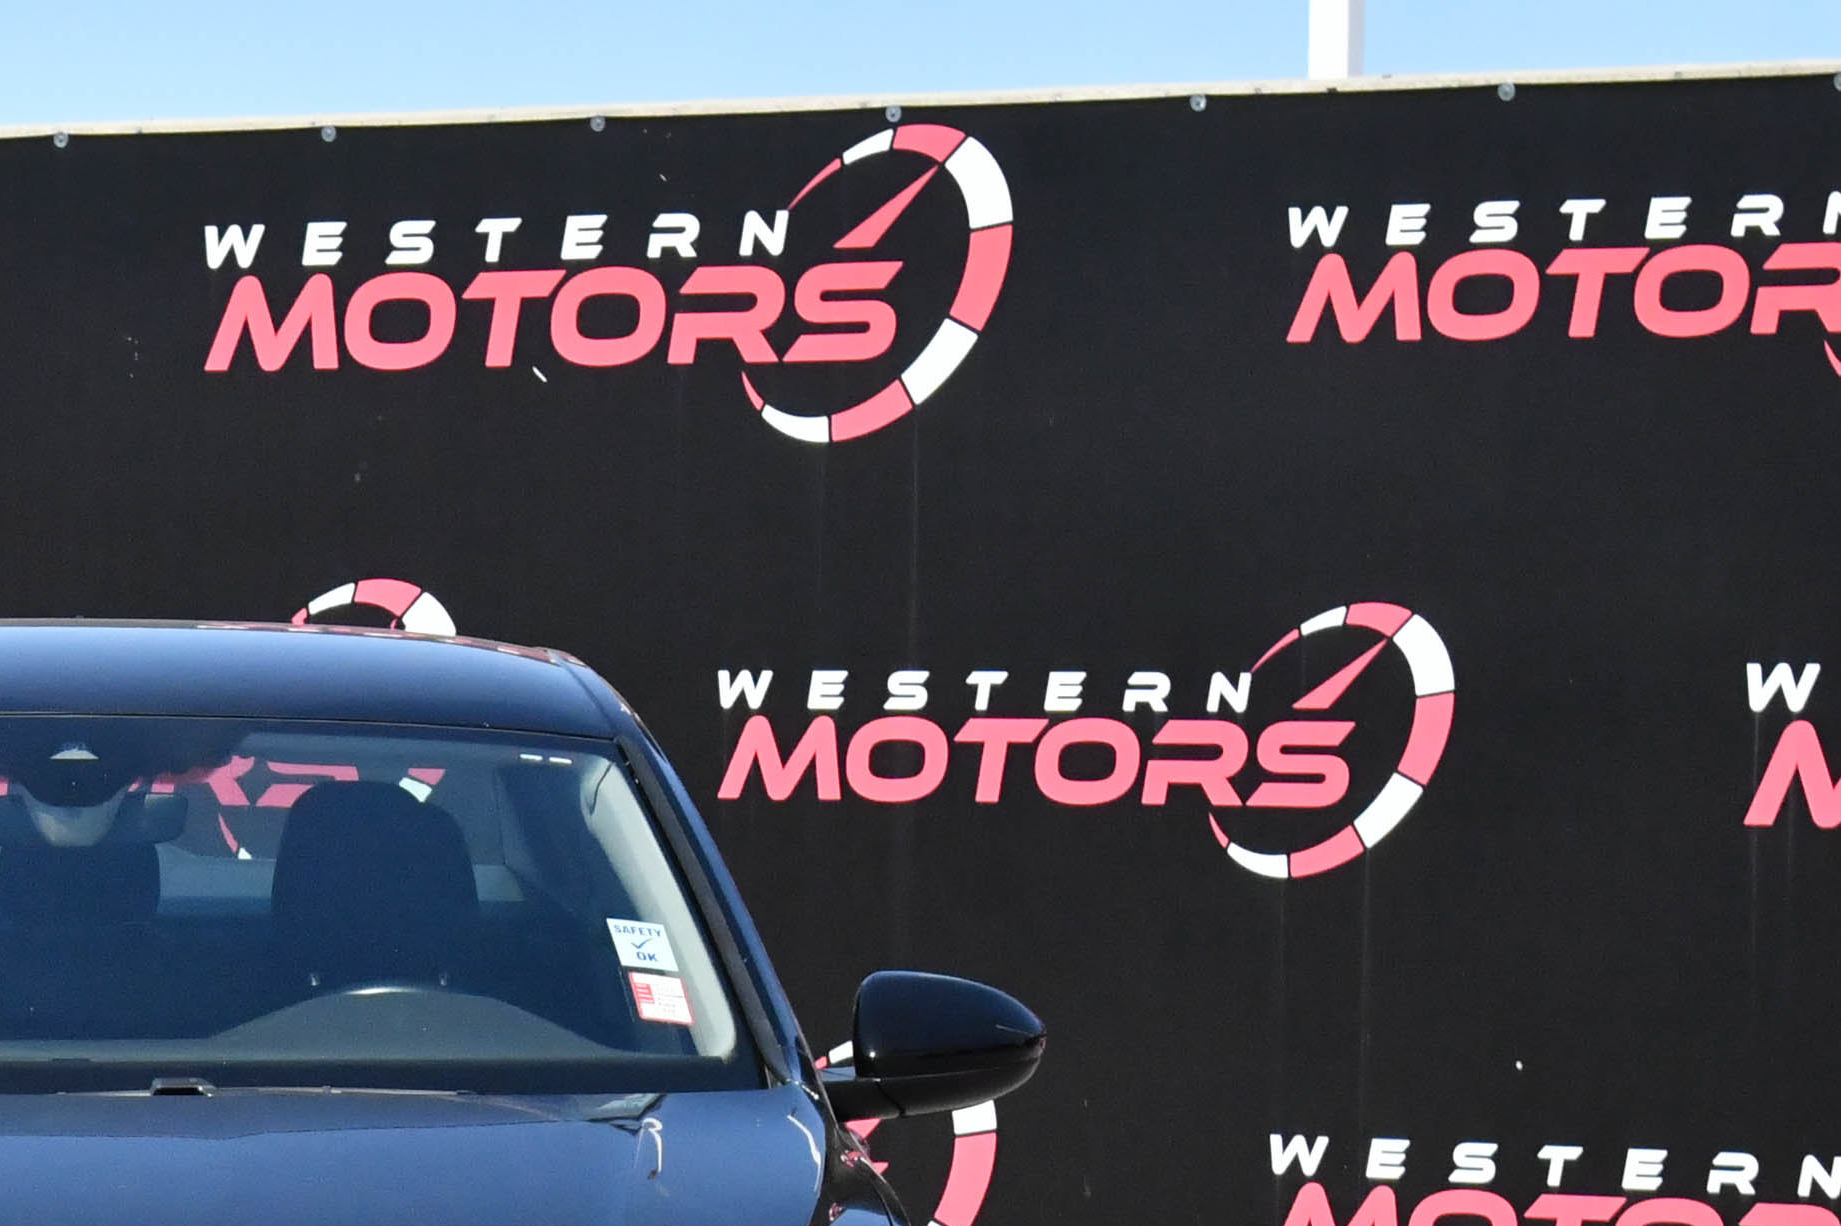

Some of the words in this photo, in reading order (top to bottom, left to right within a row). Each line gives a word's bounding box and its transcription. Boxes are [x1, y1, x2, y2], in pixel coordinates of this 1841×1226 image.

[204, 210, 790, 270] WESTERN
[204, 260, 904, 373] MOTORS
[717, 668, 1252, 714] WESTERN
[716, 714, 1357, 809] MOTORS
[613, 925, 661, 937] SAFETY
[636, 951, 658, 962] OK
[1268, 1132, 1841, 1201] WESTERN
